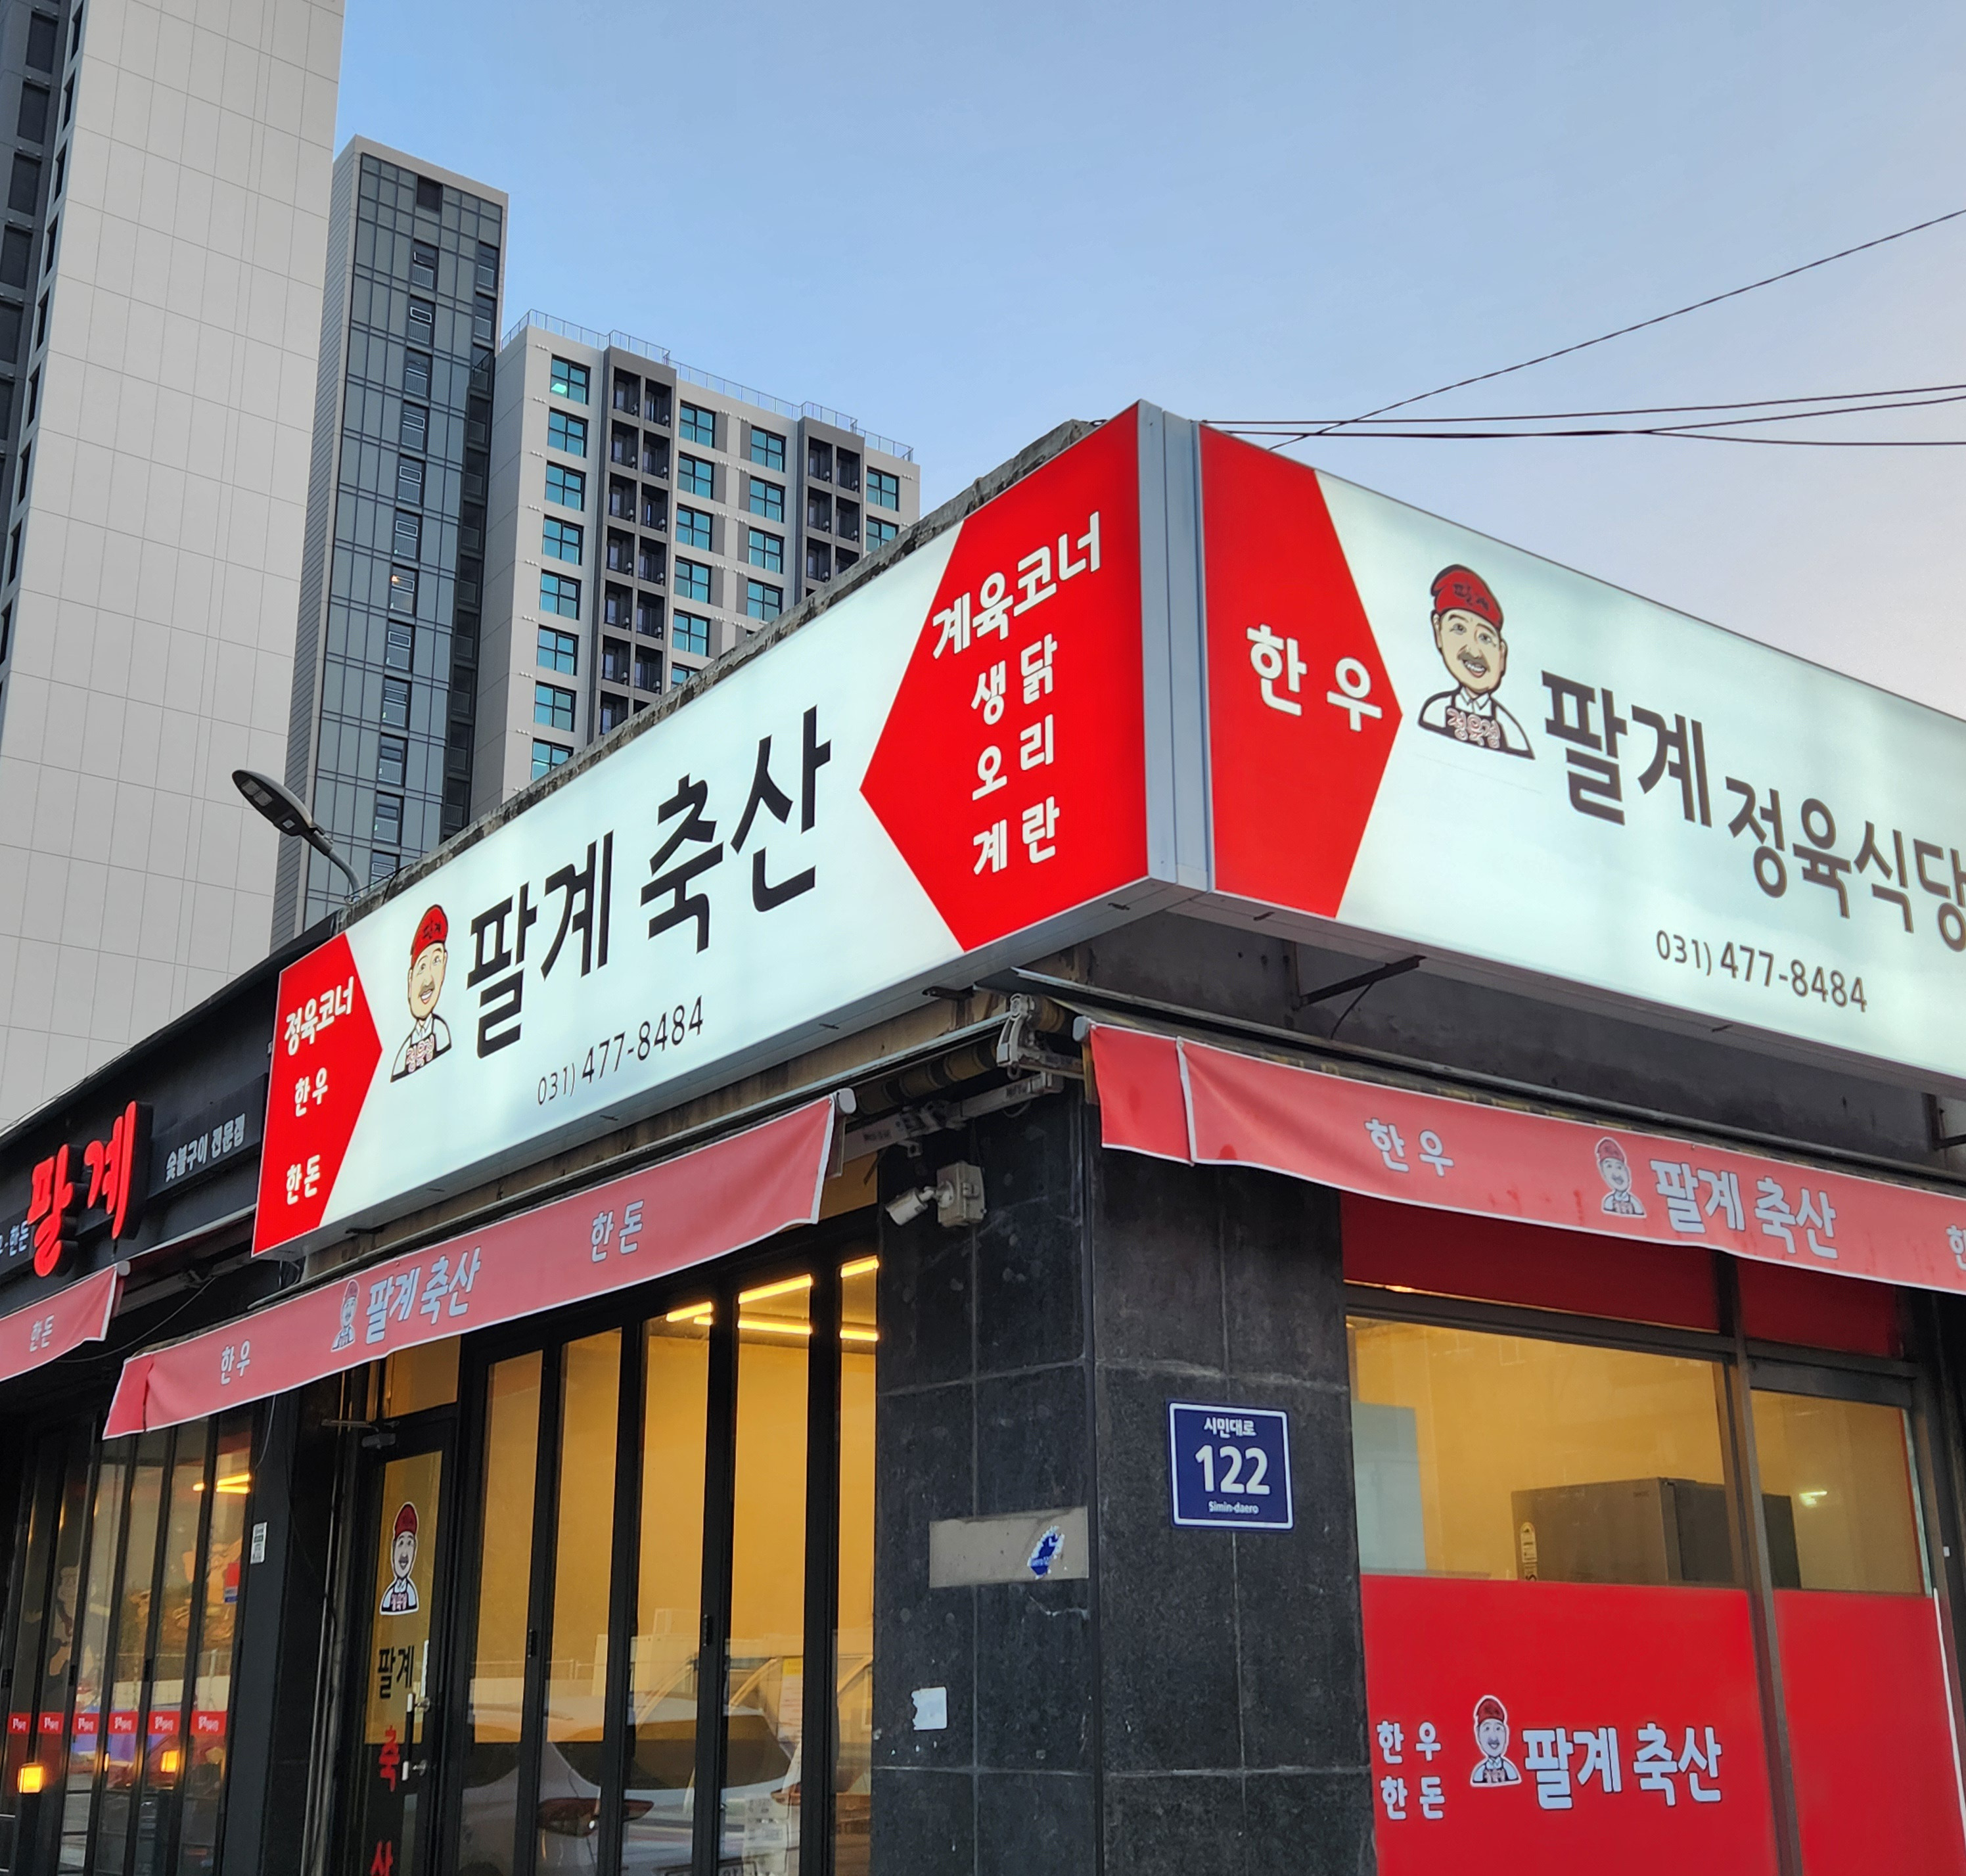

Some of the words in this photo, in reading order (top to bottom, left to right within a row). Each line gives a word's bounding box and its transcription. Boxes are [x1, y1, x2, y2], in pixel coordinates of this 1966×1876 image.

[932, 511, 1101, 659] 계육코너
[1446, 707, 1501, 748] 정육점
[1542, 670, 1712, 828] 팔계
[1725, 776, 1966, 952] 정육식당
[467, 829, 614, 1059] 팔계
[640, 704, 832, 954] 축산
[284, 976, 354, 1056] 정육코너
[165, 1132, 208, 1183] 숯불구이
[211, 1112, 246, 1159] 전문점
[1649, 1159, 1745, 1233] 팔계
[1754, 1176, 1838, 1260] 축산
[366, 1266, 422, 1344] 팔계
[419, 1246, 481, 1325] 축산
[29, 1315, 55, 1352] 한돈
[221, 1339, 250, 1386] 한우
[1204, 1417, 1256, 1438] 시민대로
[1195, 1445, 1270, 1495] 122
[1208, 1501, 1260, 1514] Simin-daero
[378, 1645, 414, 1699] 팔계
[1521, 1726, 1622, 1810] 팔계
[1633, 1722, 1722, 1807] 축산
